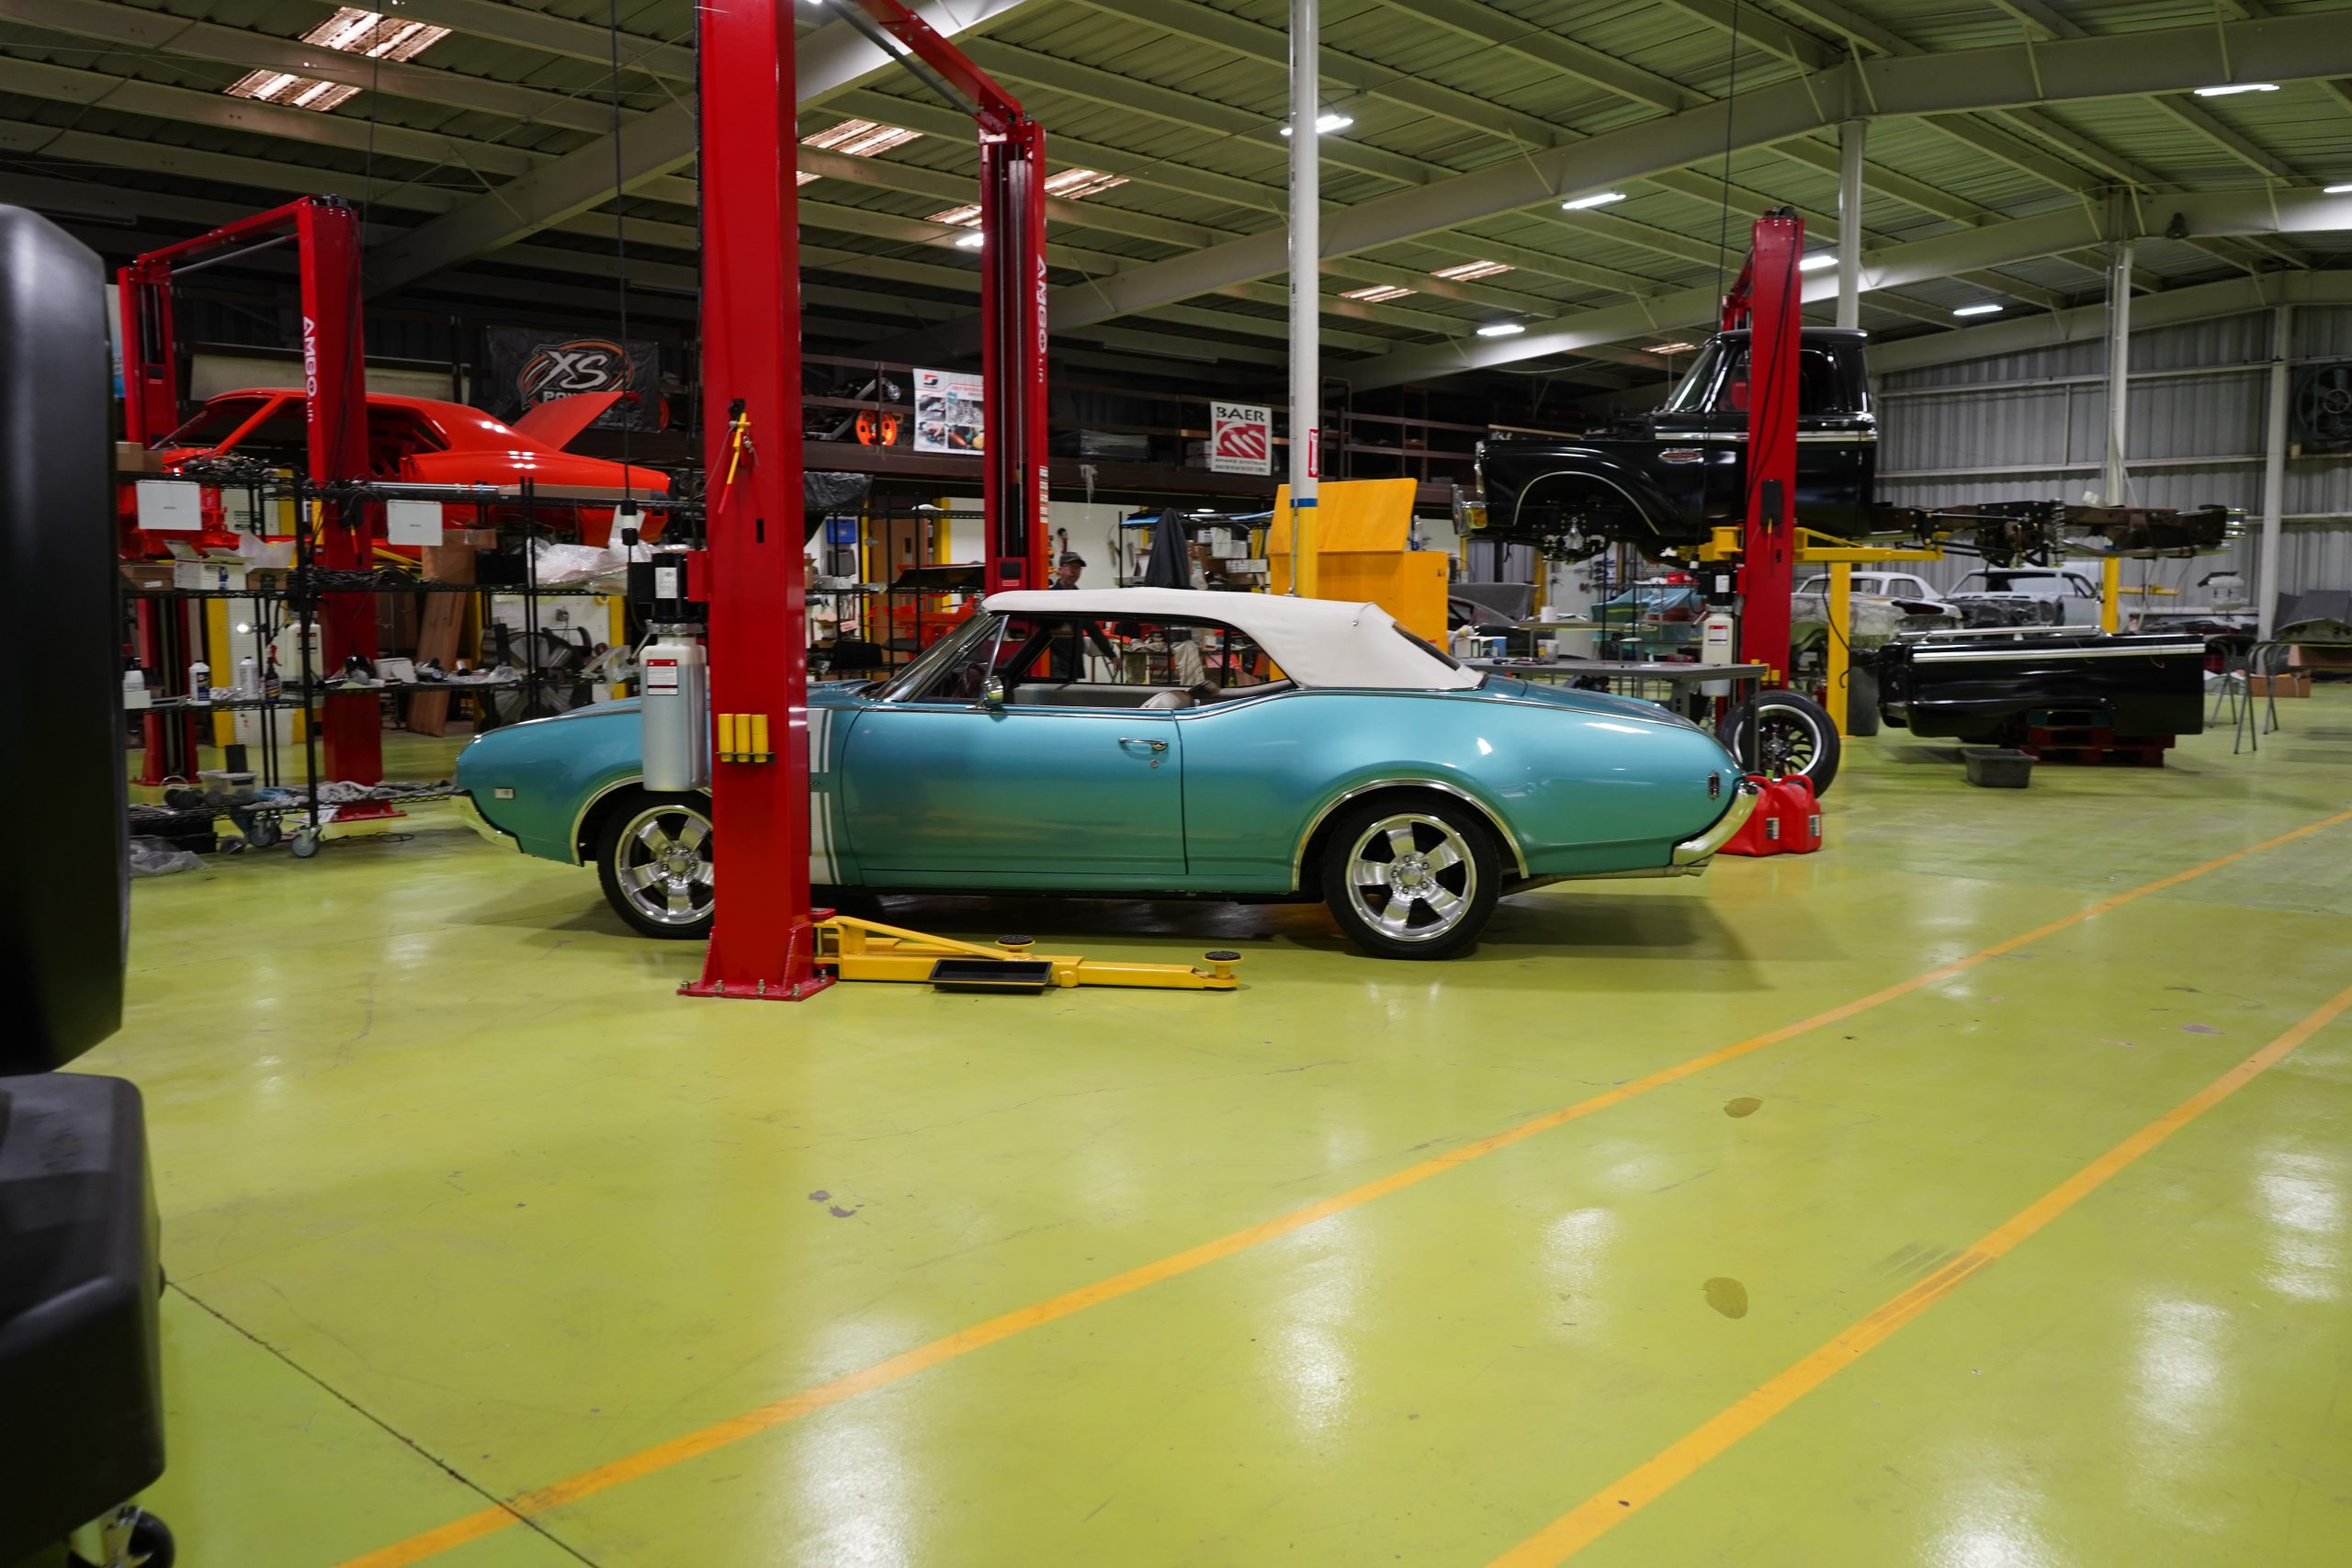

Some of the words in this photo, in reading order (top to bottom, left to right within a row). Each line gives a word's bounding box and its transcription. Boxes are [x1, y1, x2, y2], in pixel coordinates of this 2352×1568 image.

[1036, 254, 1048, 355] AMGO
[302, 316, 318, 398] AMGO
[531, 349, 609, 394] XS
[1216, 406, 1265, 423] BAER
